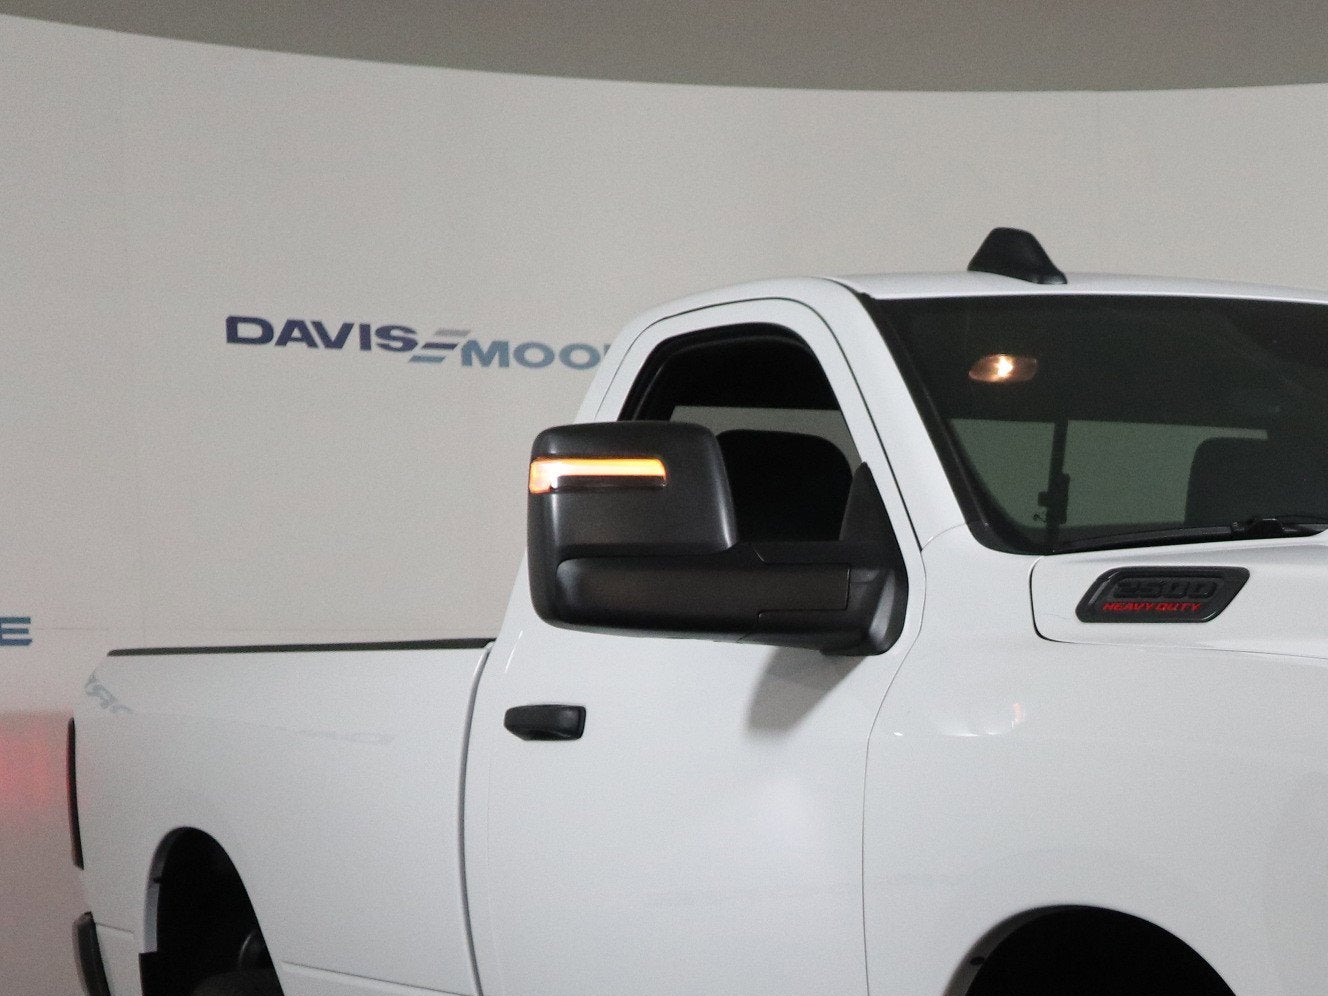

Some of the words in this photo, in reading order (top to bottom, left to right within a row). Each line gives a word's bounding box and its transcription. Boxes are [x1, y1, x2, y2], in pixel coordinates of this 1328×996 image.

[225, 315, 419, 353] DAVIS
[460, 339, 611, 371] MOO
[1112, 580, 1218, 599] 2500
